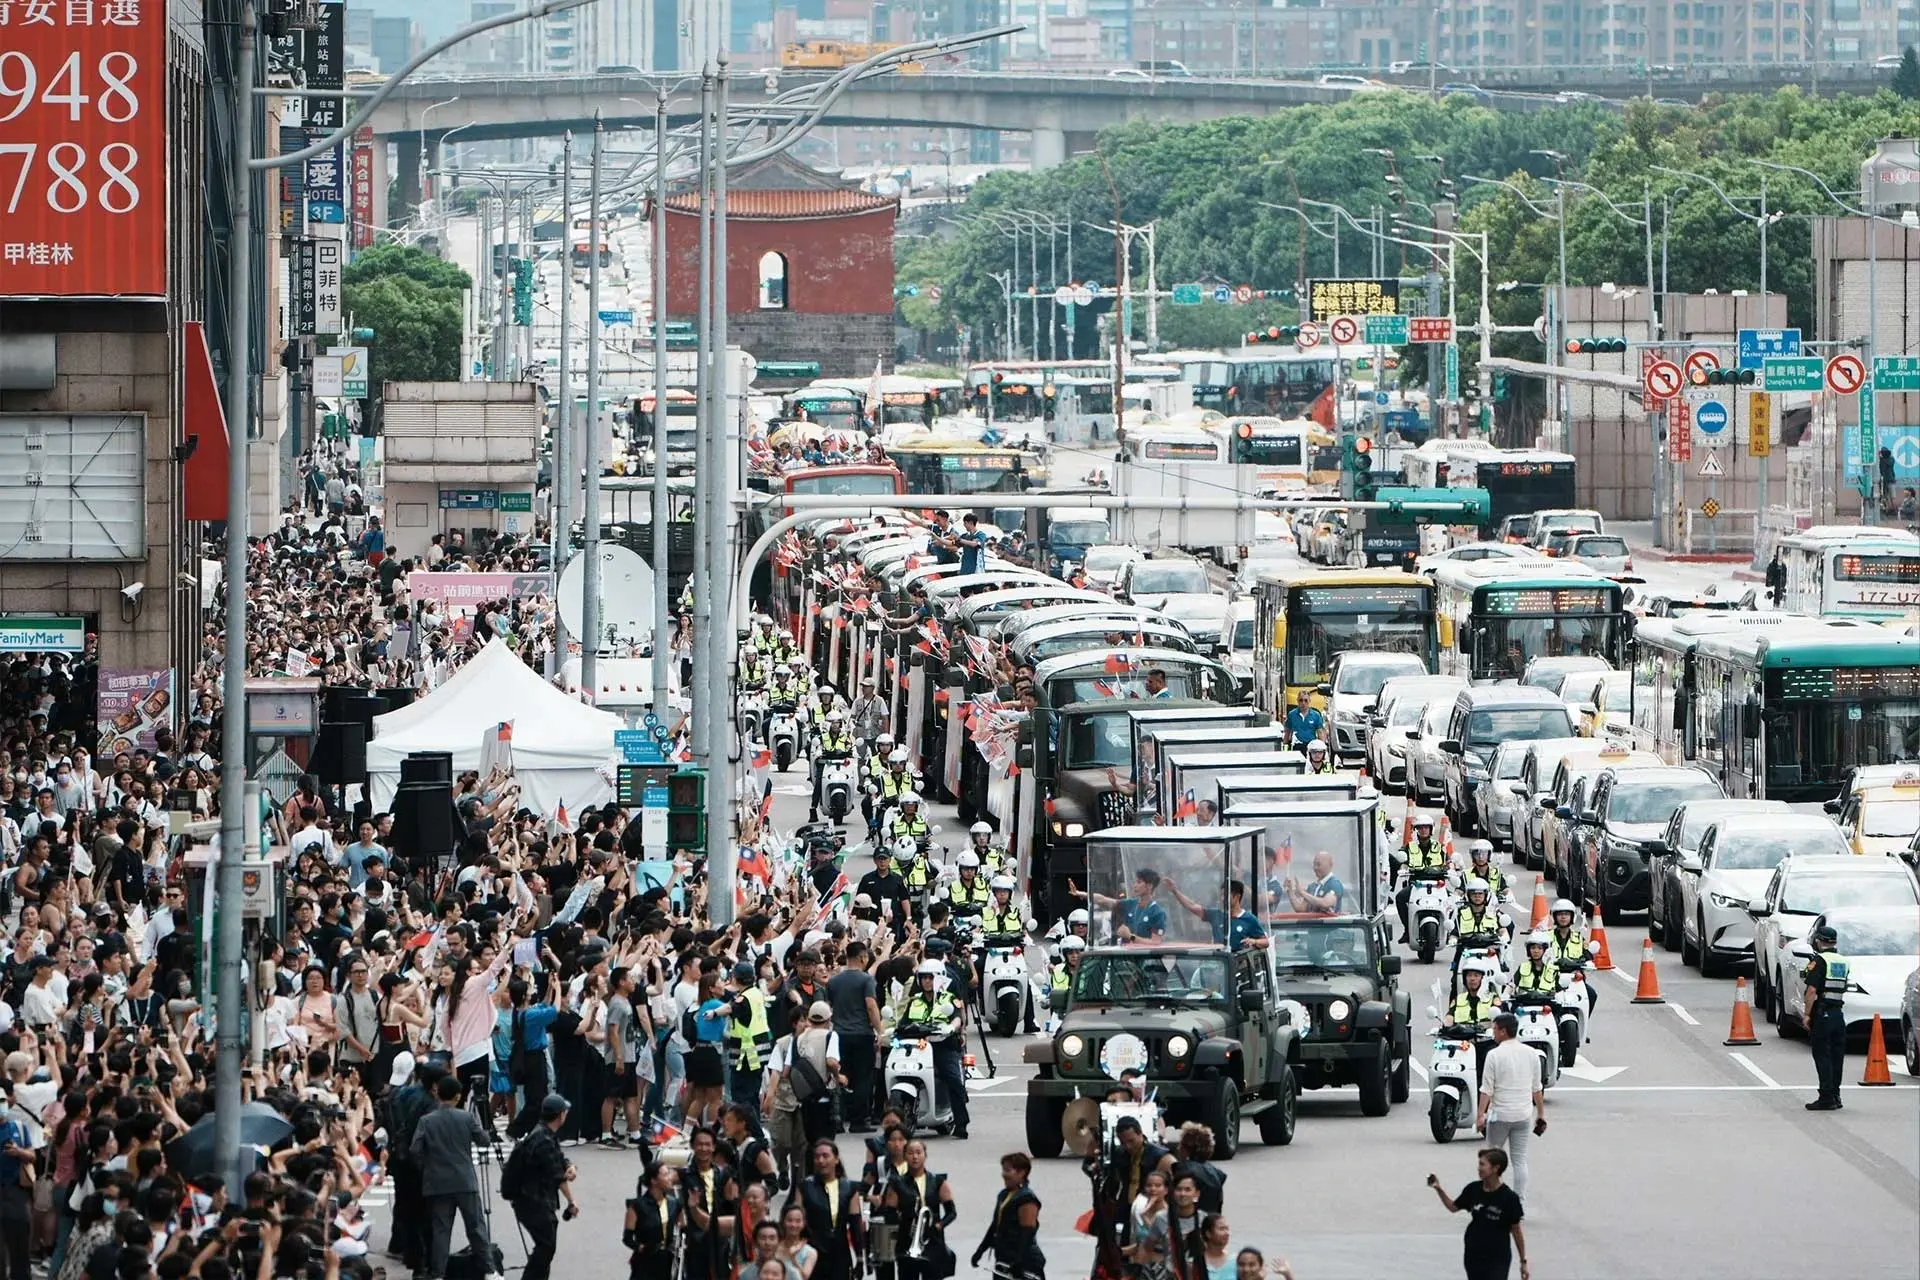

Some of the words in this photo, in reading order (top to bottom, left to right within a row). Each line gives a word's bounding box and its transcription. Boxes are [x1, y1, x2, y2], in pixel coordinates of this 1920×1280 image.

[312, 112, 334, 126] 4F
[0, 143, 140, 214] 788
[304, 190, 341, 200] HOTEL
[312, 206, 333, 220] 3F
[4, 243, 74, 266] 甲桂林
[302, 246, 313, 313] 國際商務中心
[319, 246, 337, 312] 巴菲特
[301, 321, 314, 331] 2F
[1742, 341, 1798, 351] 公車專用
[1879, 359, 1920, 369] 館前
[1766, 365, 1807, 377] 重慶南路
[443, 585, 507, 598] 站前地下街
[521, 580, 549, 597] Z2
[645, 716, 657, 725] C4
[655, 728, 667, 737] C4
[661, 742, 673, 751] C4
